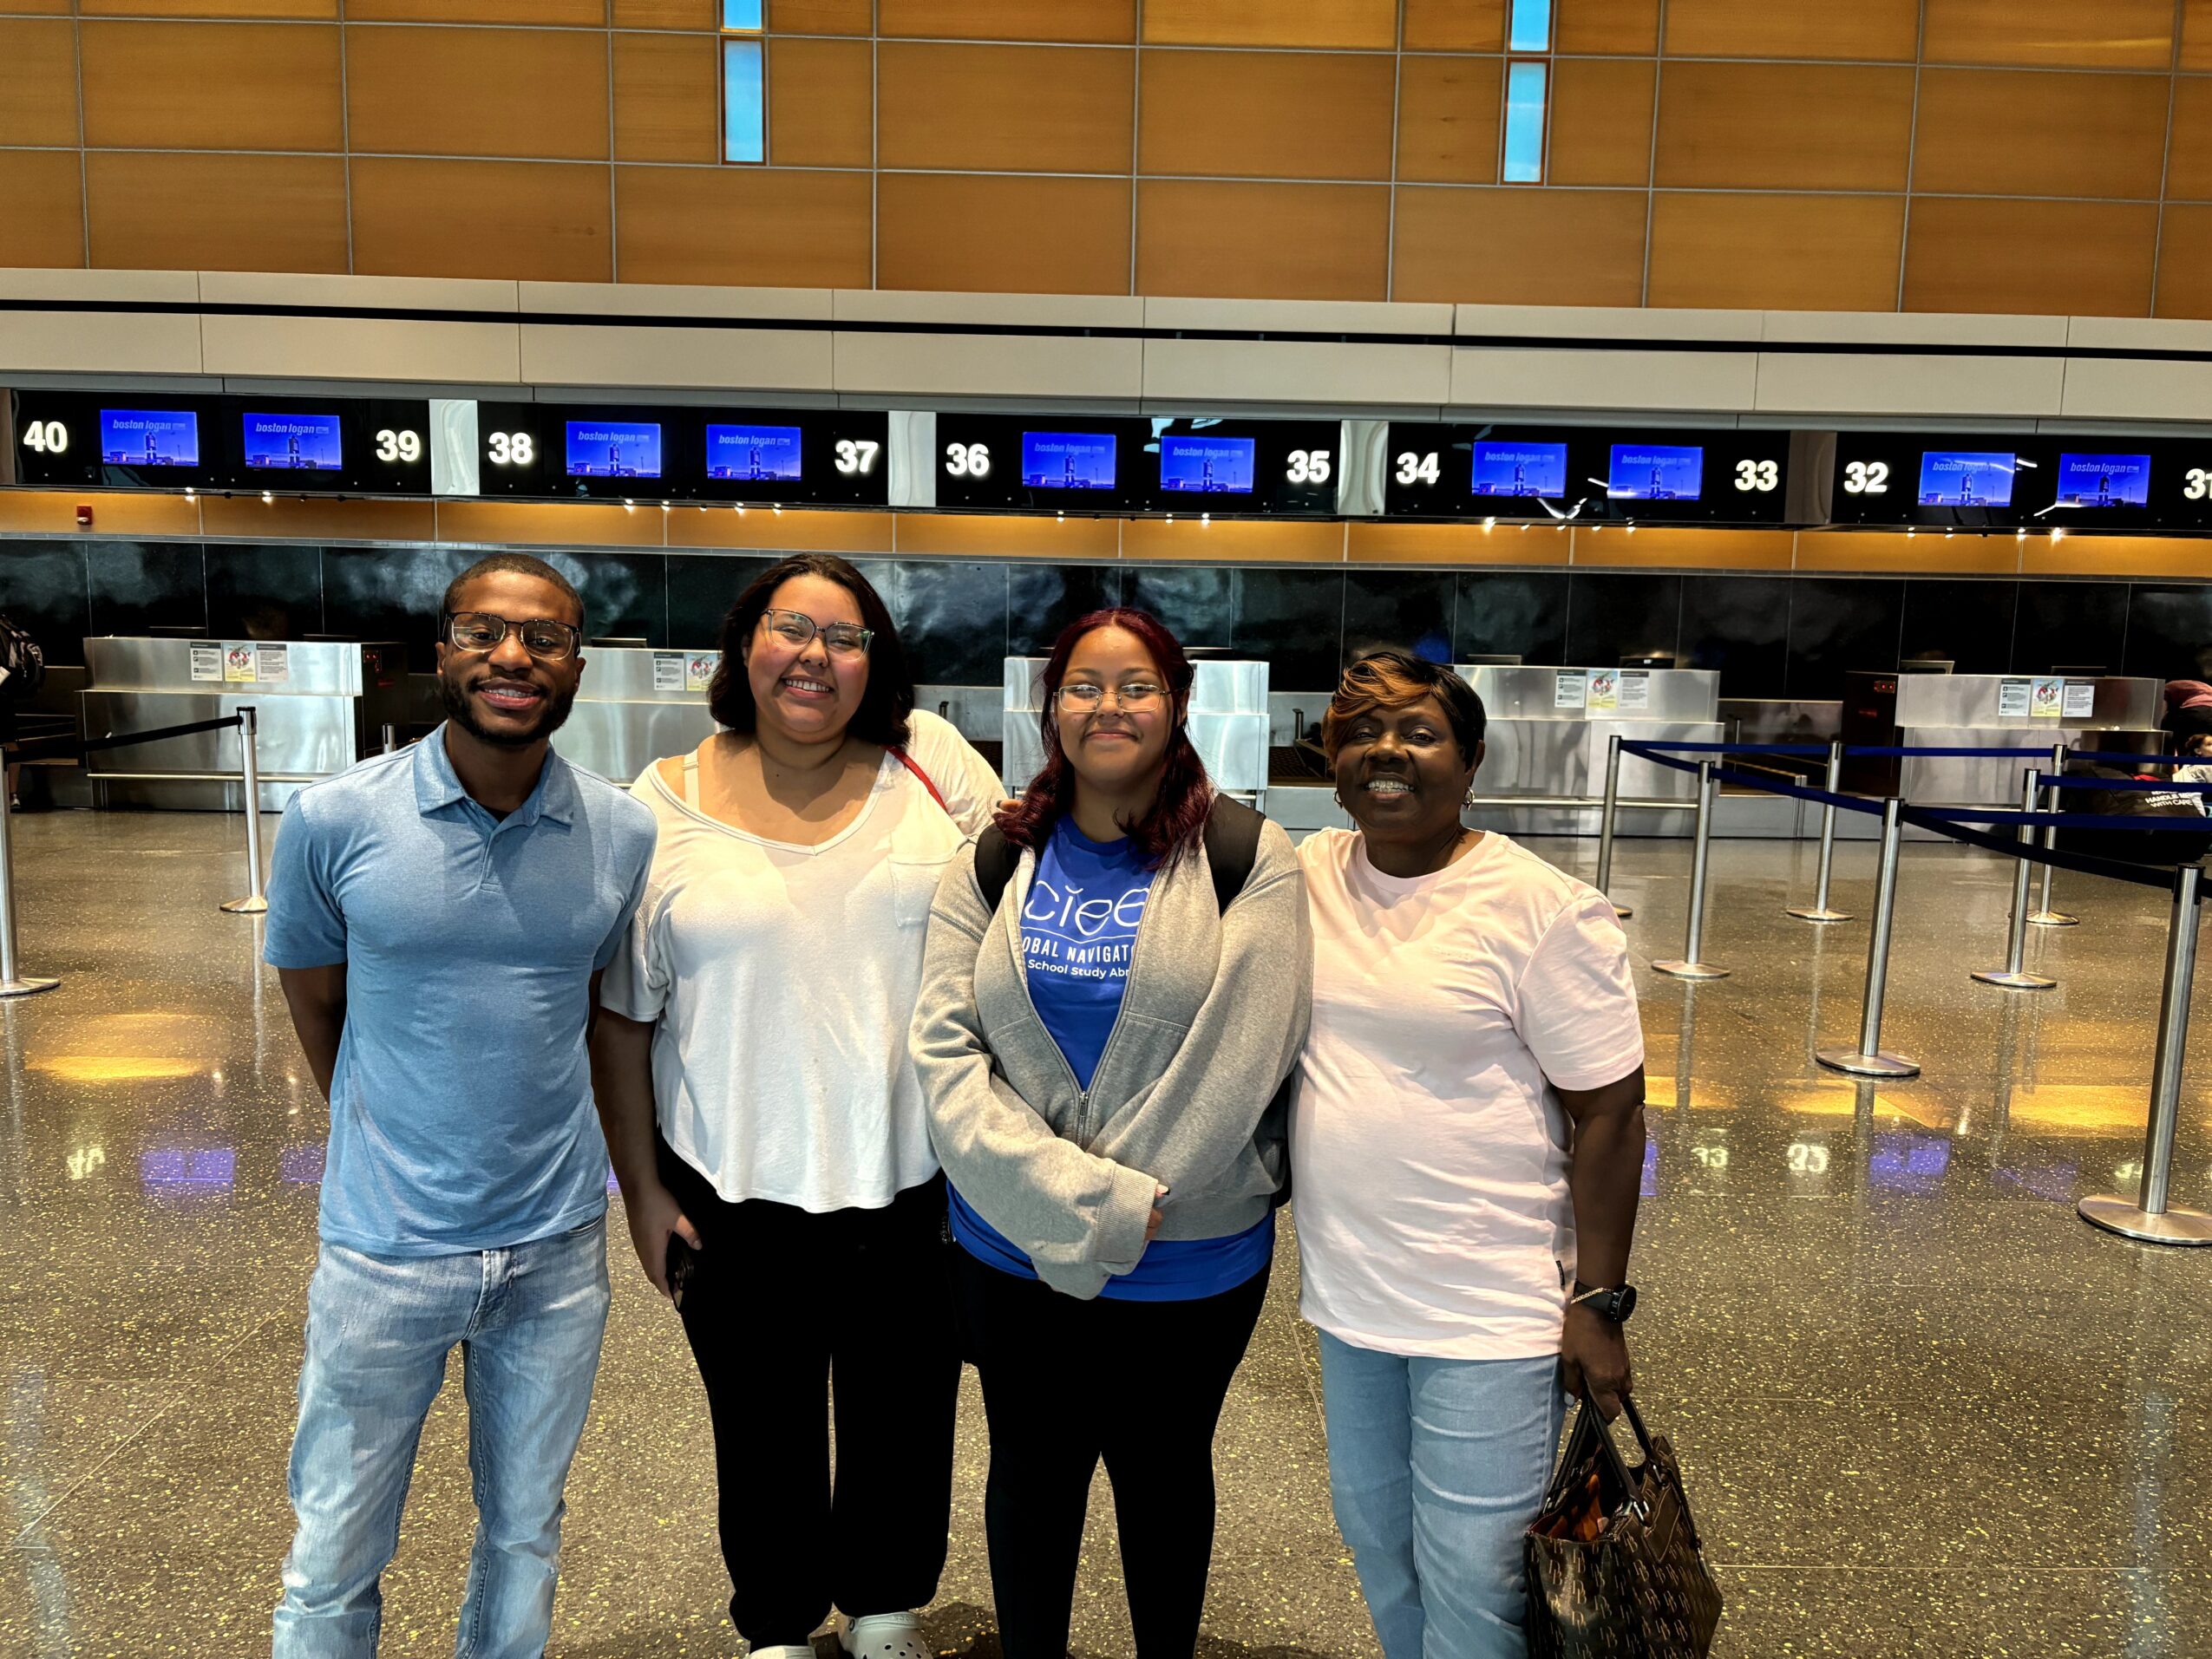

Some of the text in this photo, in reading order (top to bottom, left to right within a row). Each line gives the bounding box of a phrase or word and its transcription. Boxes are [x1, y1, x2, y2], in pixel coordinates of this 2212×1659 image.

[23, 421, 68, 453] 40
[113, 419, 172, 432] boston logan
[256, 423, 315, 435] boston logan
[578, 431, 636, 444] boston logan
[718, 434, 776, 447] boston logan
[376, 429, 421, 461] 39
[488, 432, 533, 464] 38
[835, 441, 879, 473] 37
[946, 443, 990, 475] 36
[1173, 447, 1203, 456] boston
[1287, 450, 1331, 482] 35
[1397, 452, 1440, 484] 34
[1735, 460, 1778, 492] 33
[1844, 461, 1888, 493] 32
[2070, 462, 2125, 475] boston logan
[1027, 959, 1068, 974] School
[1070, 966, 1107, 979] Study
